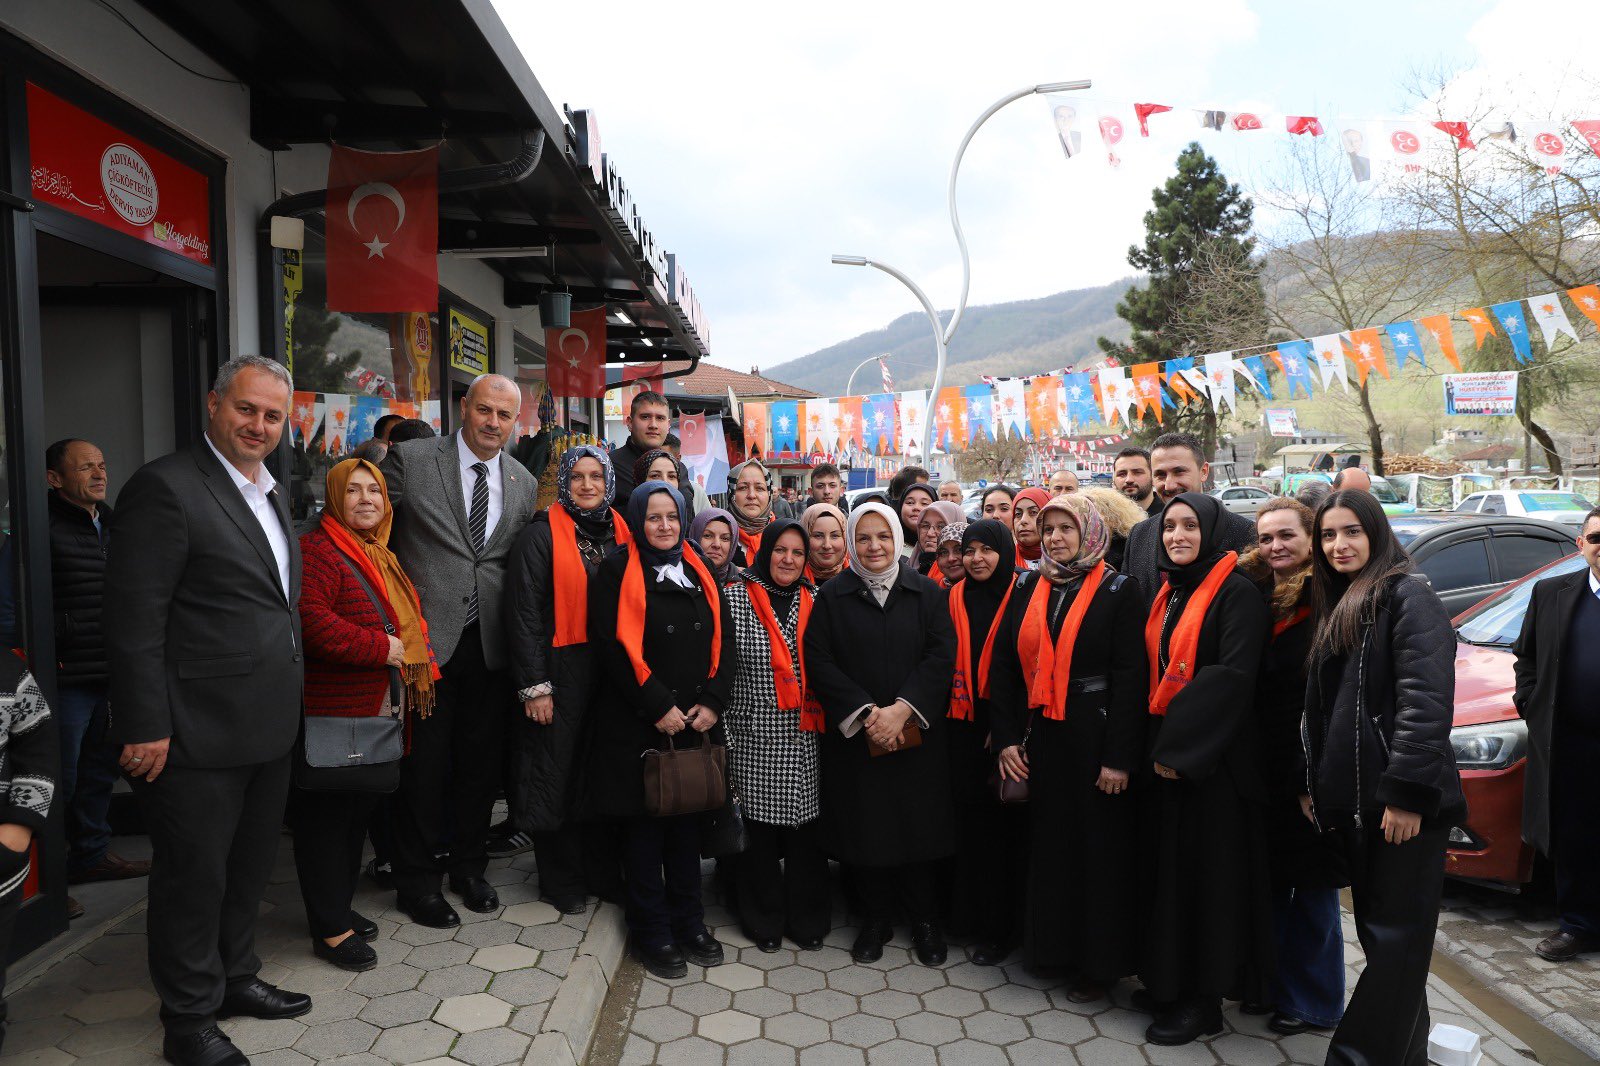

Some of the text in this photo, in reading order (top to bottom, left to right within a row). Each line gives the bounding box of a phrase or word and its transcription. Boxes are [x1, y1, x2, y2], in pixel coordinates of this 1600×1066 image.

[108, 168, 153, 198] ÇİĞKÖFTECİSİ
[110, 153, 151, 184] ADIYAMAN
[109, 187, 155, 220] DERVİŞ YAŞAR
